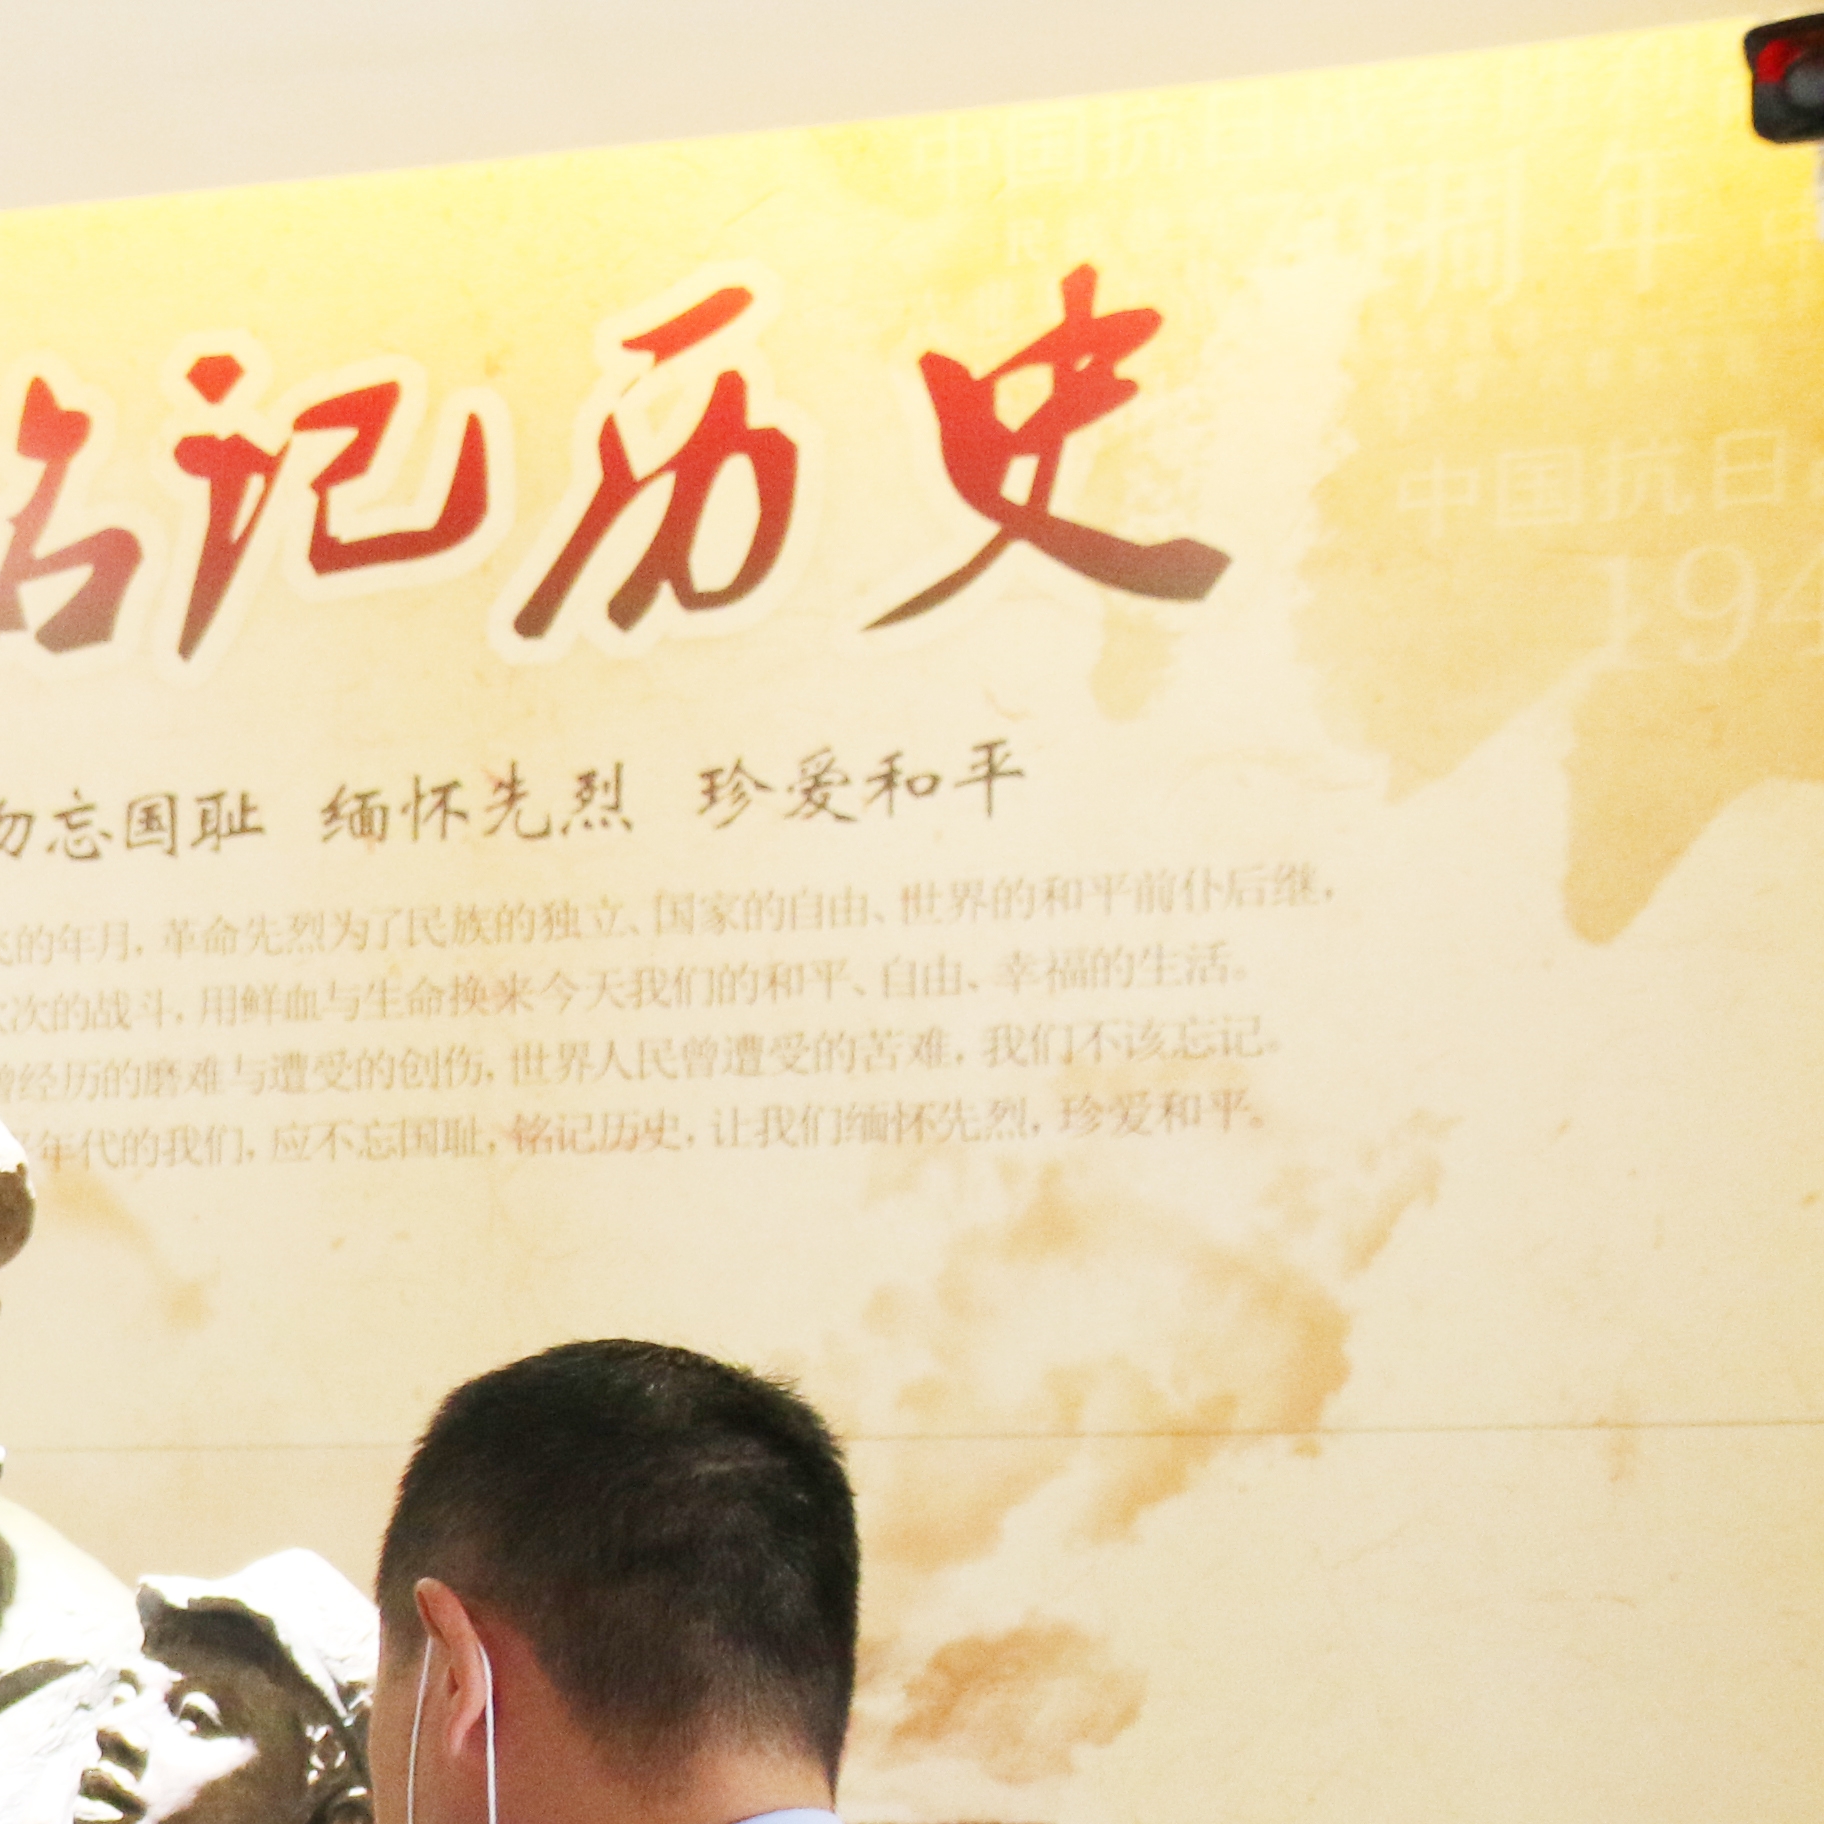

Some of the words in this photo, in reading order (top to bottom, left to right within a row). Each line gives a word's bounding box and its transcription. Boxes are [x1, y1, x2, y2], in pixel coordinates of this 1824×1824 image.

[1397, 426, 1824, 540] 中国抗日
[319, 761, 635, 846] 缅怀先烈
[697, 737, 1028, 827] 珍爱和平
